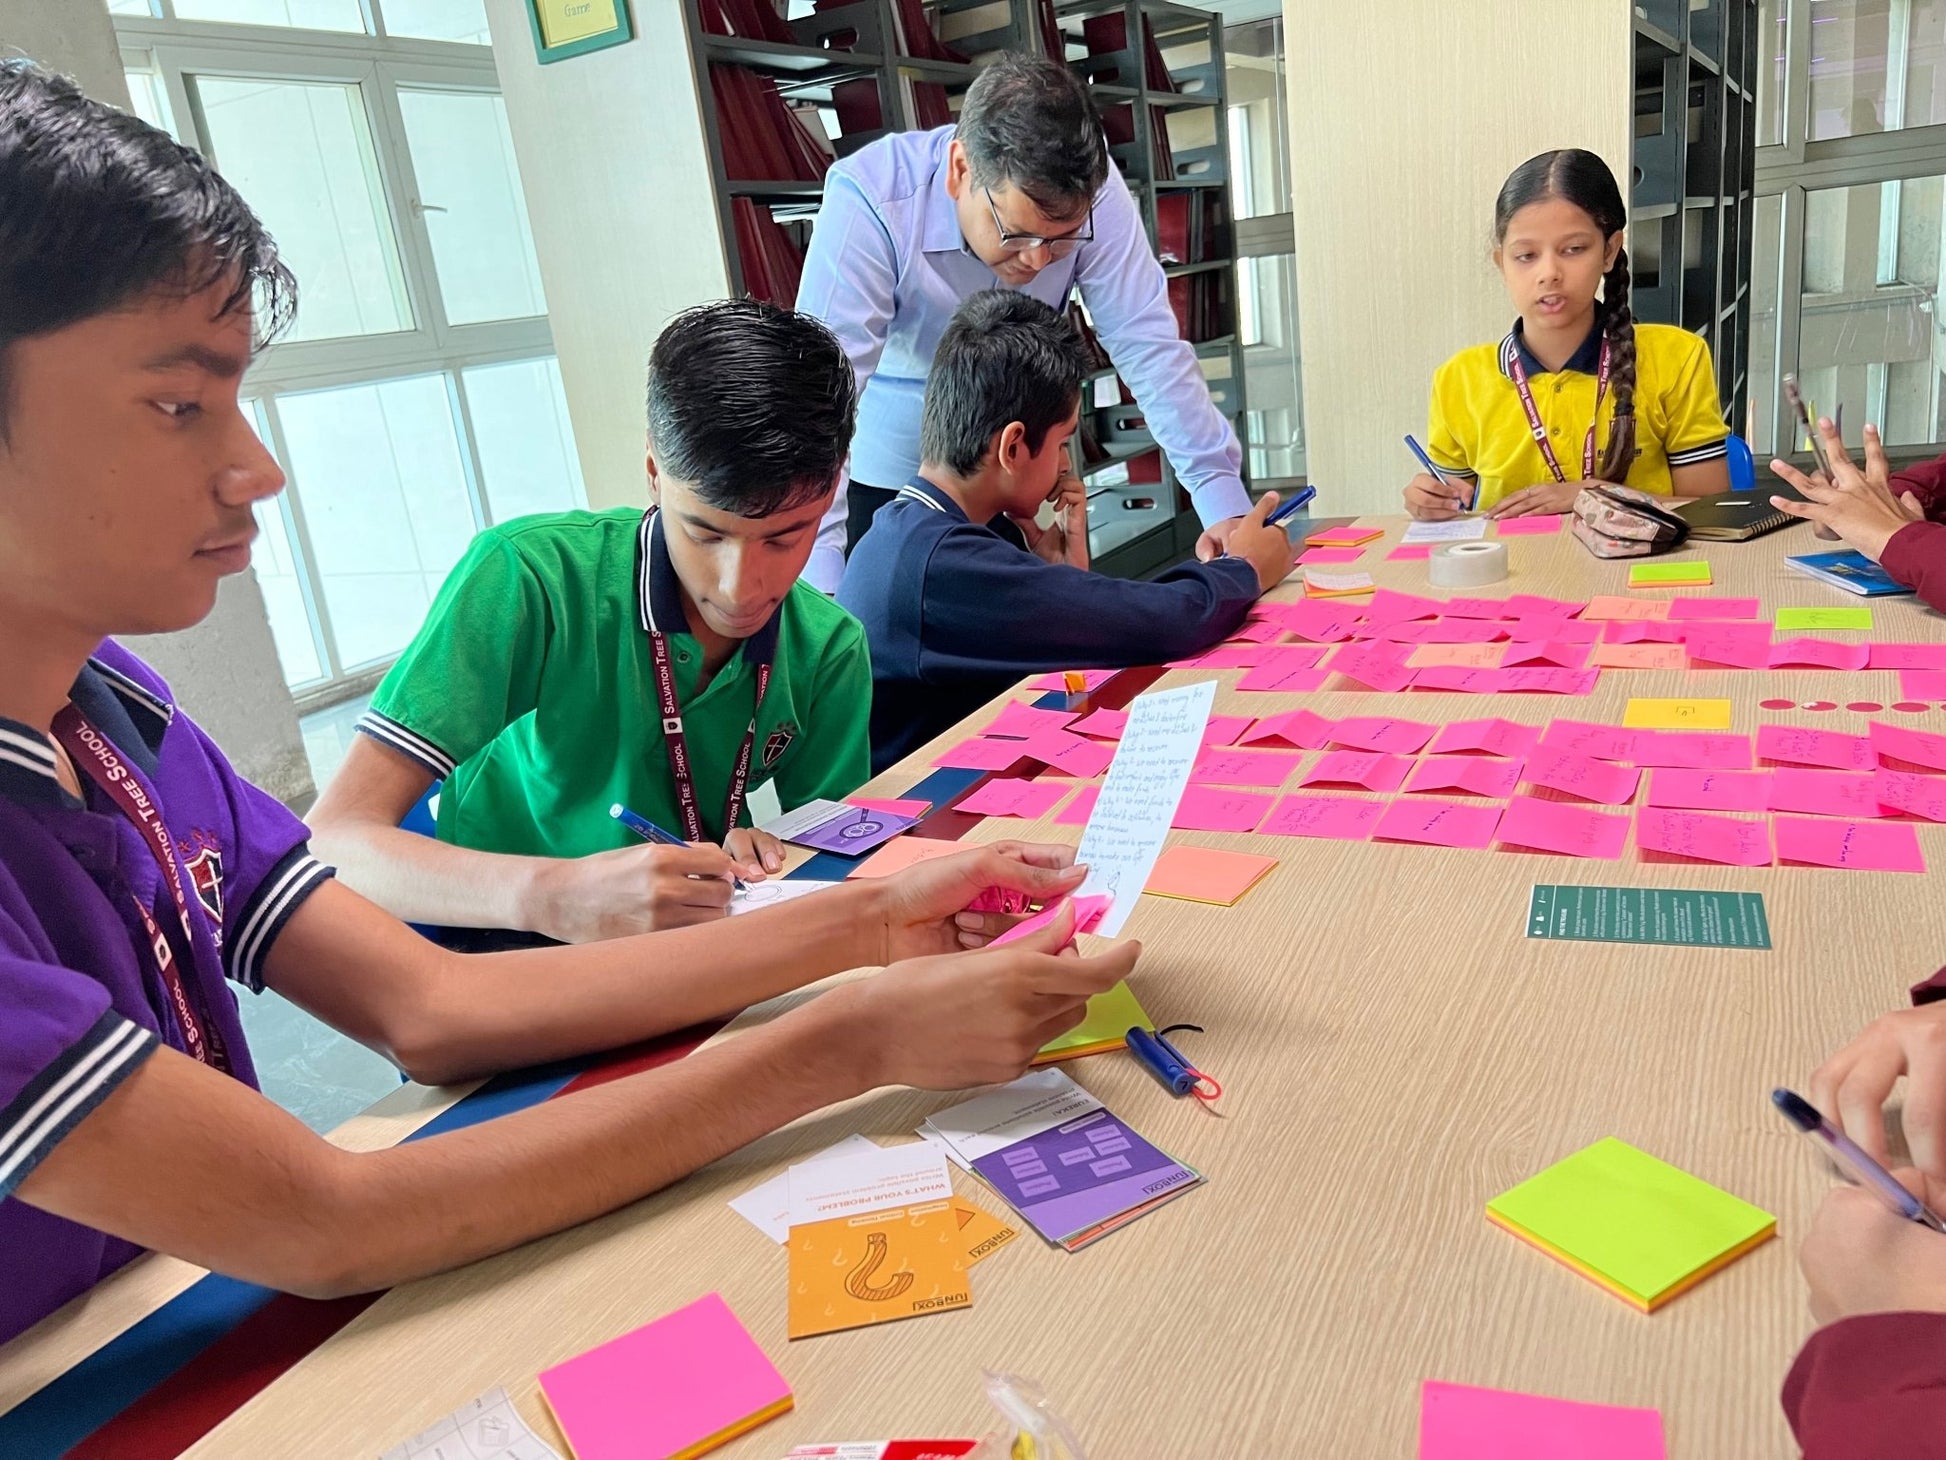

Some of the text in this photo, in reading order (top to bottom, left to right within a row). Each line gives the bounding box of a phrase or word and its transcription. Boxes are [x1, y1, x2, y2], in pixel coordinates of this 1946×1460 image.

[655, 639, 667, 664] TREE
[661, 667, 674, 714] SALVATION
[736, 742, 750, 777] SCHOOL
[731, 776, 745, 802] TREE
[76, 720, 185, 904] SALVATION TREE SCHOOL
[173, 979, 199, 1044] SCHOOL
[817, 1183, 946, 1212] WHAT'S YOUR PROBLEM?
